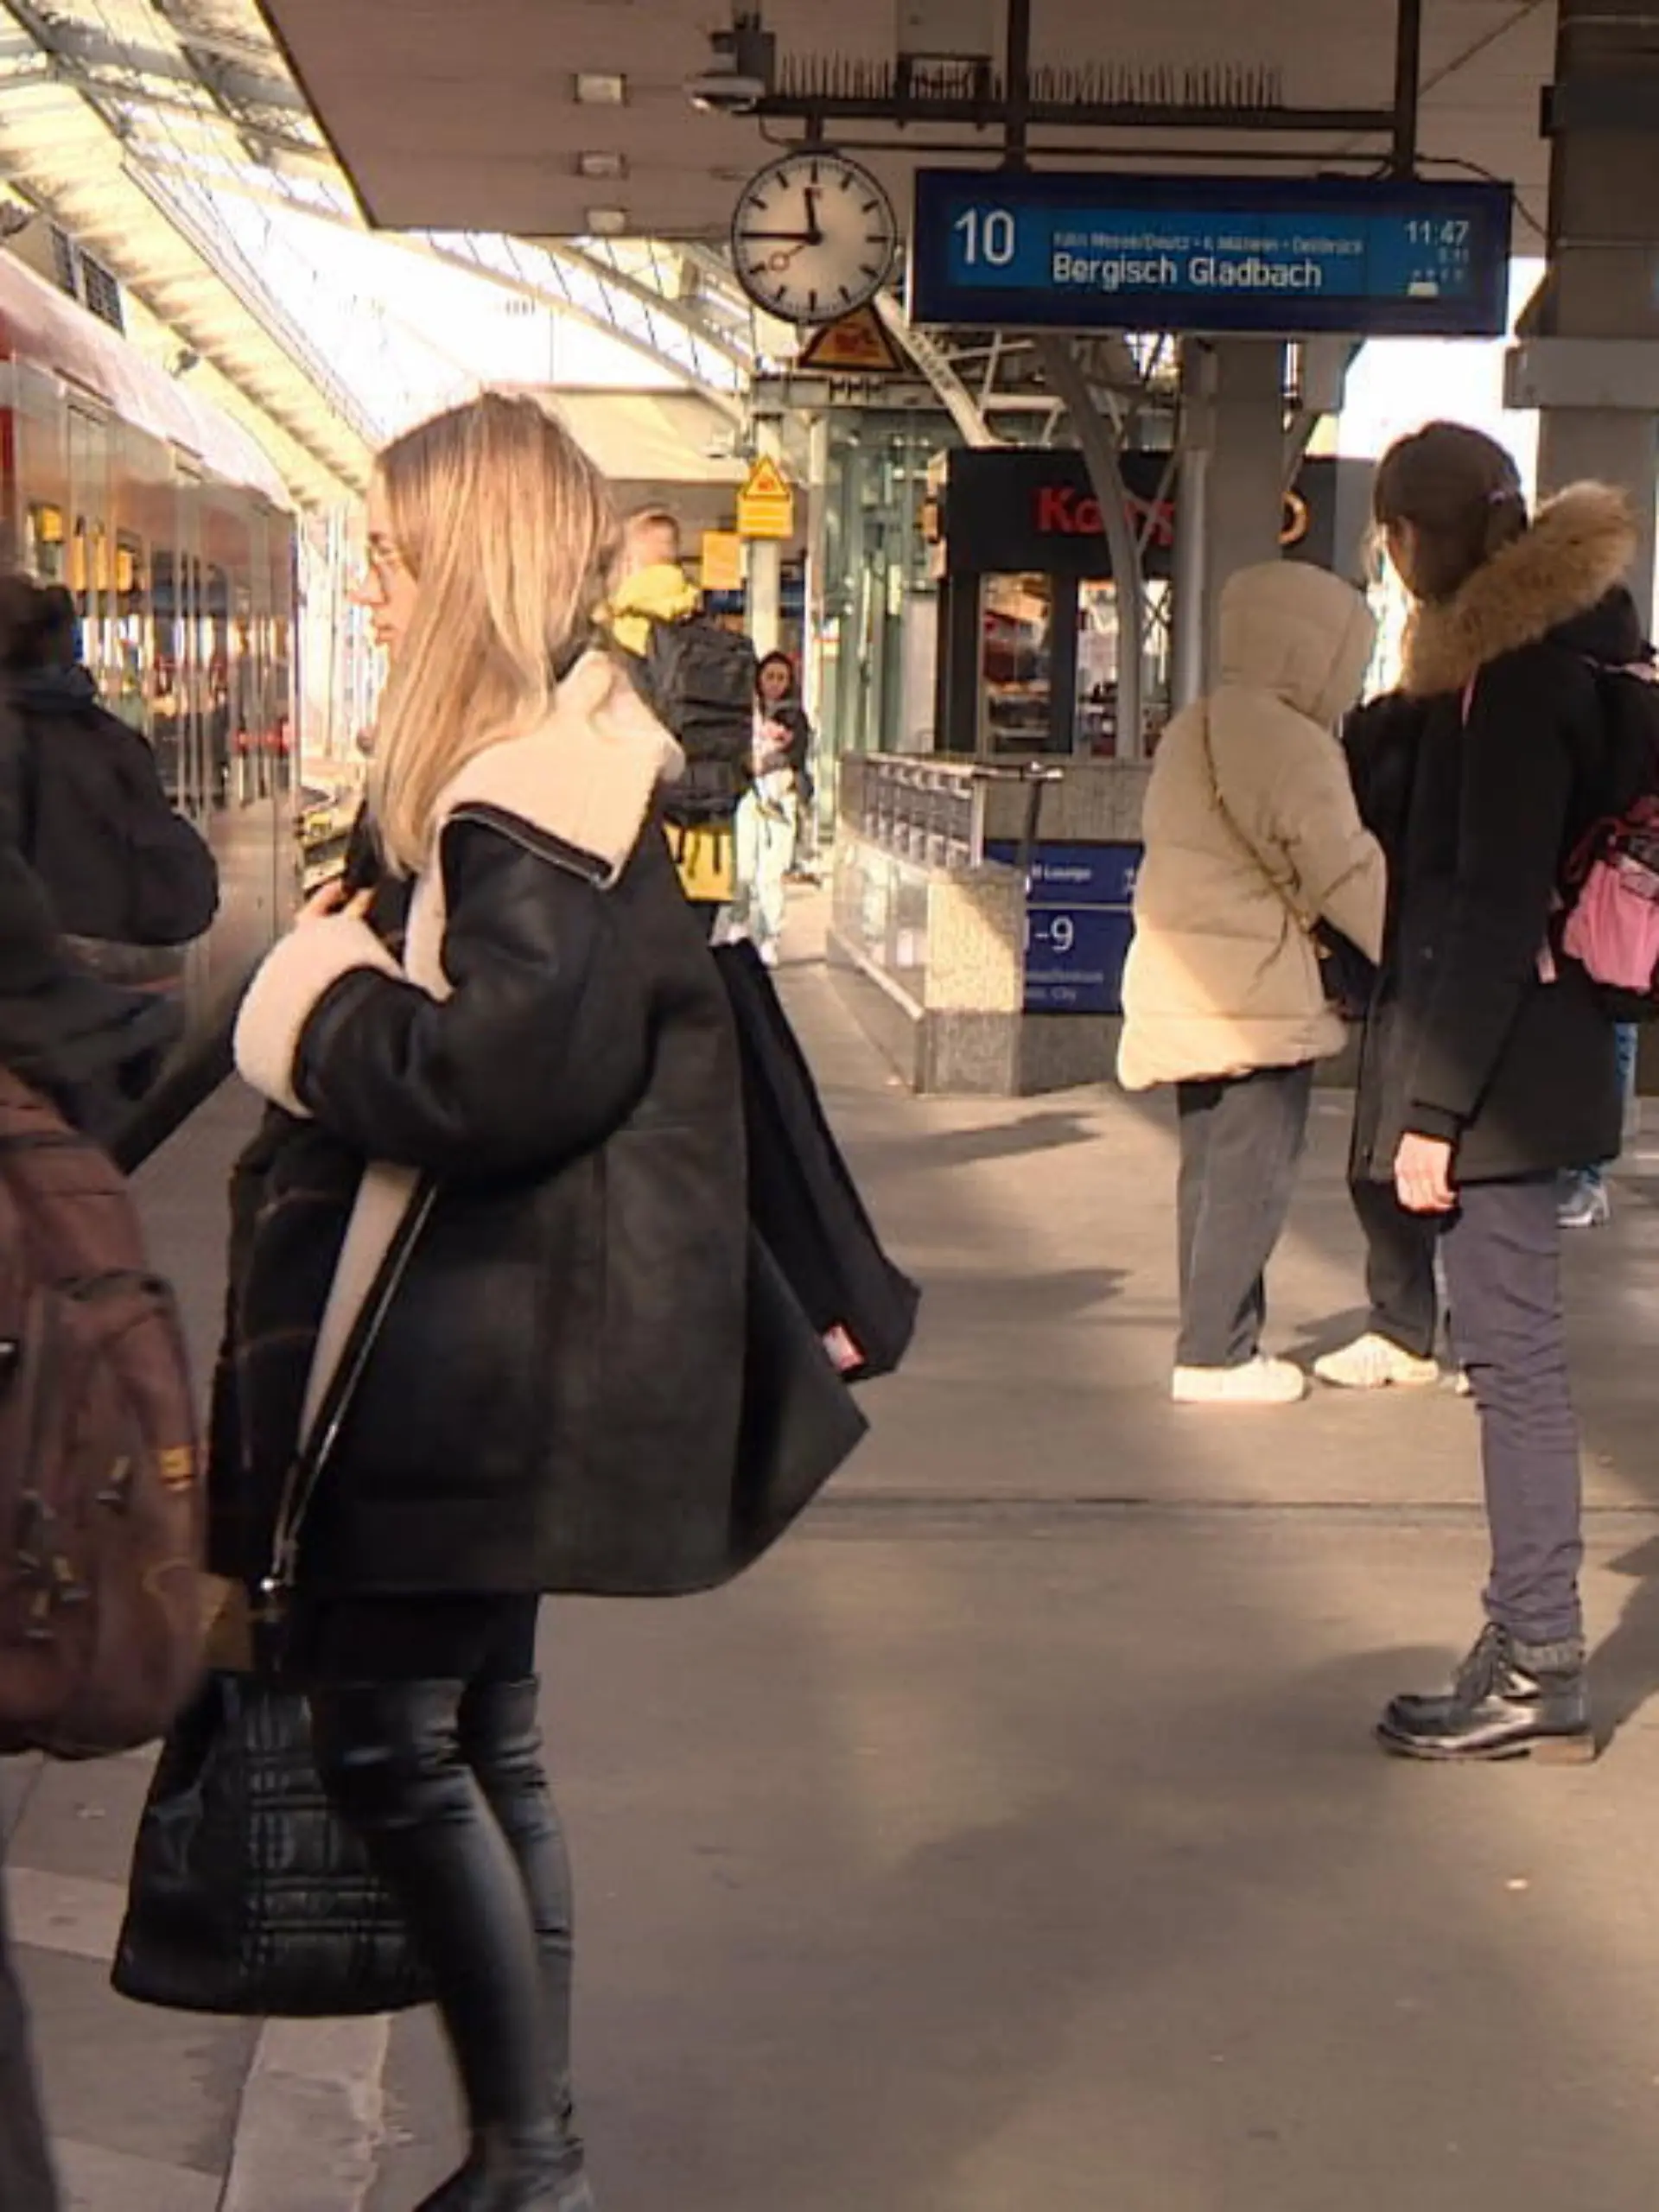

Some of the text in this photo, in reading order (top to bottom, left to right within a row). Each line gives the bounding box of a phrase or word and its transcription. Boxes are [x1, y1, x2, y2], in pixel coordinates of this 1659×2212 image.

[955, 209, 1015, 264] 10
[1403, 219, 1469, 245] 11:47
[1052, 251, 1322, 290] Bergisch Gladbach
